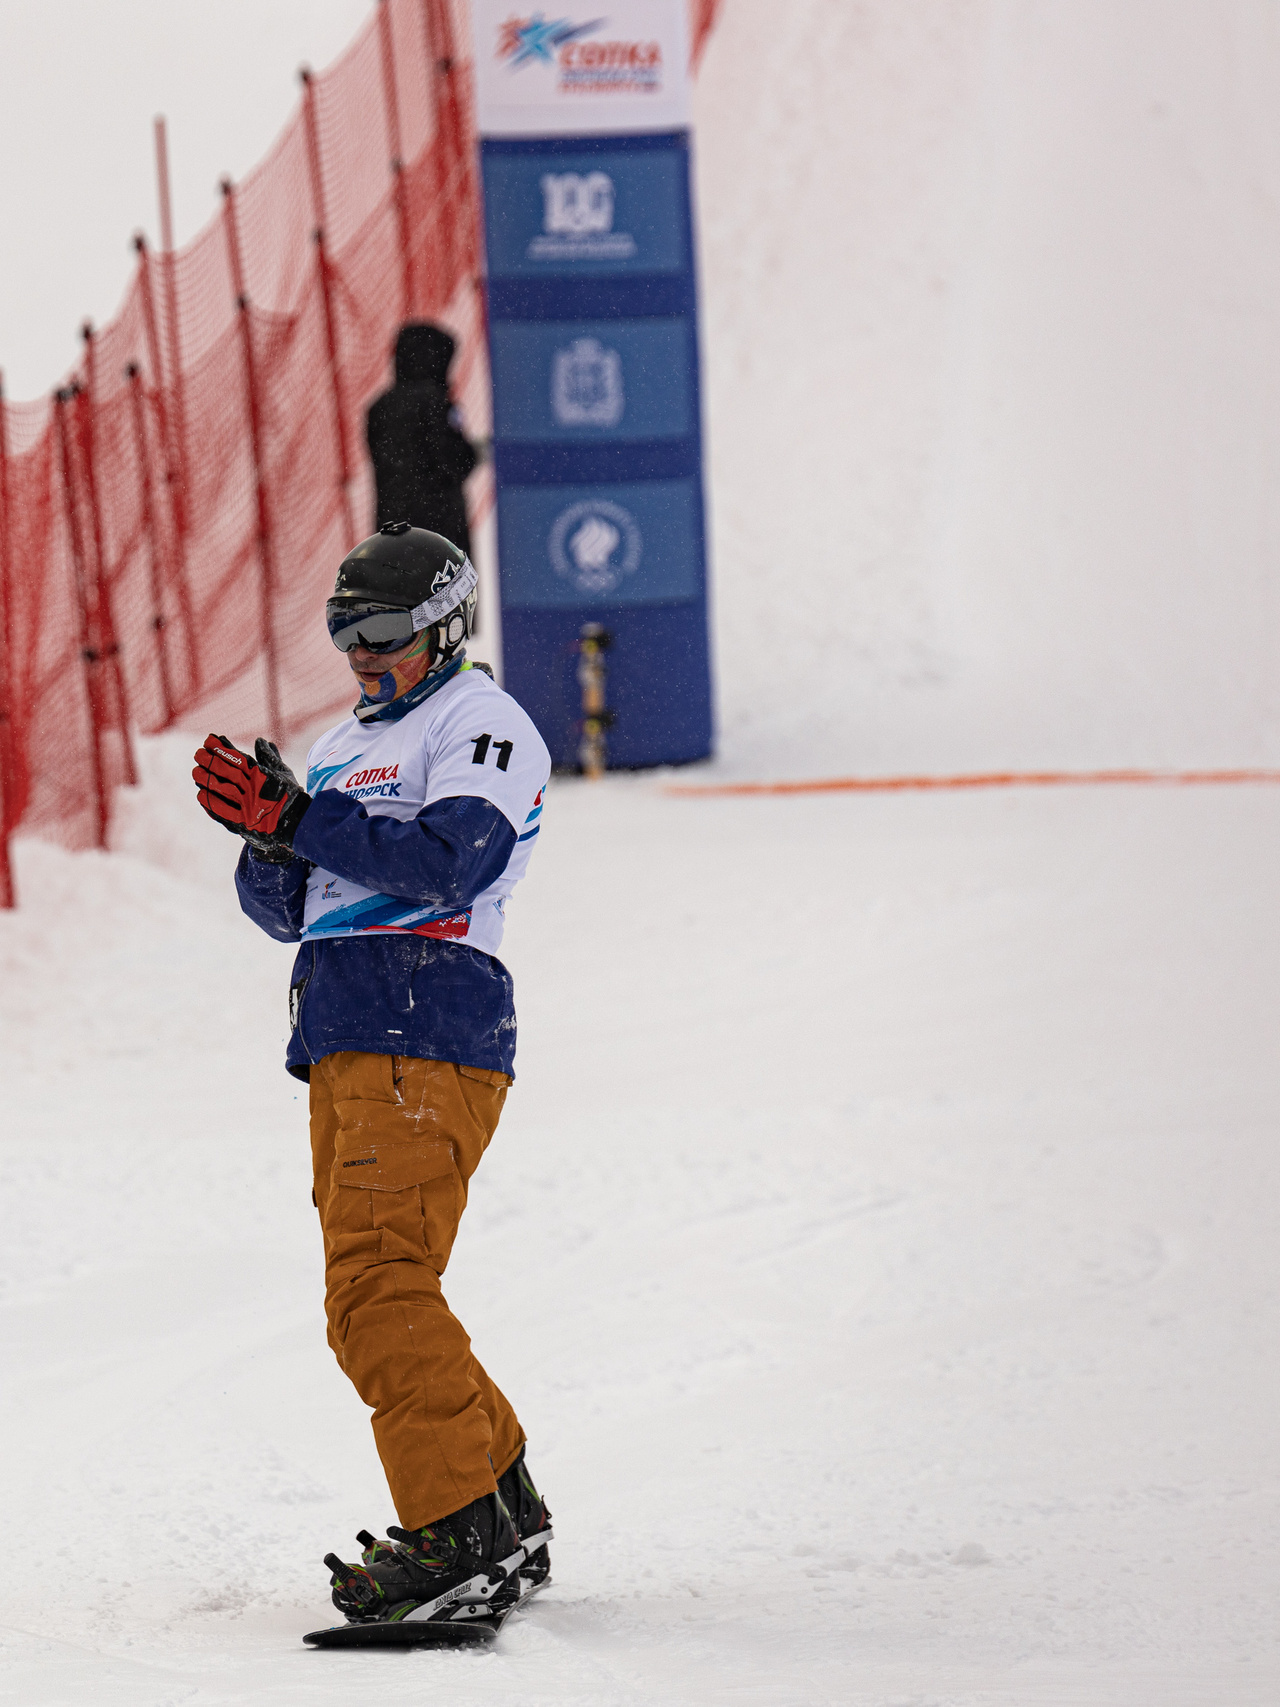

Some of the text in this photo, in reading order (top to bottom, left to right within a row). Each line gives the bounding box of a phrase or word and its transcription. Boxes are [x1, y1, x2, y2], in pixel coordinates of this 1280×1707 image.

[213, 747, 242, 765] reusch
[470, 732, 514, 772] 11
[345, 763, 400, 789] СОПКА
